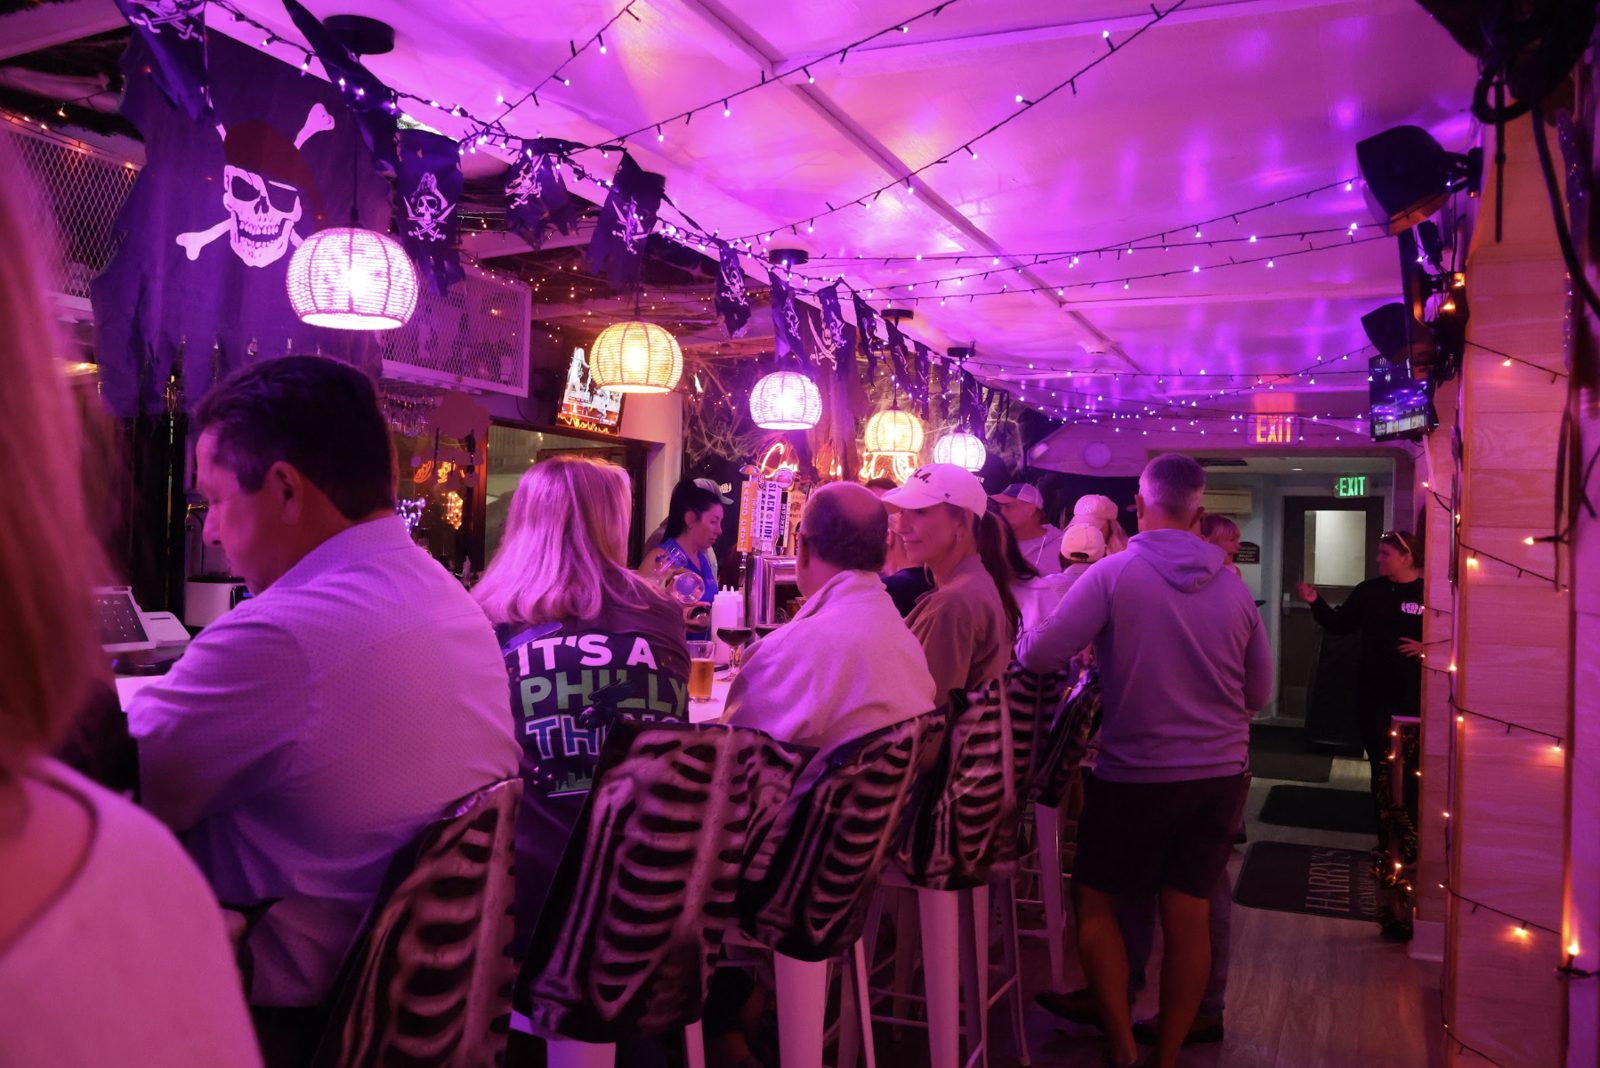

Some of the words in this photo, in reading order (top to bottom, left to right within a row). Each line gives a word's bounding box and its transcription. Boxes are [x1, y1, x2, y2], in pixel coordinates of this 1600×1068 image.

[1256, 415, 1294, 443] EXIT
[766, 482, 777, 512] SLACK
[1339, 476, 1366, 497] EXIT
[764, 521, 773, 540] TIDE
[517, 634, 613, 676] IT'S
[626, 637, 658, 670] A
[1305, 848, 1352, 912] HARRY'S
